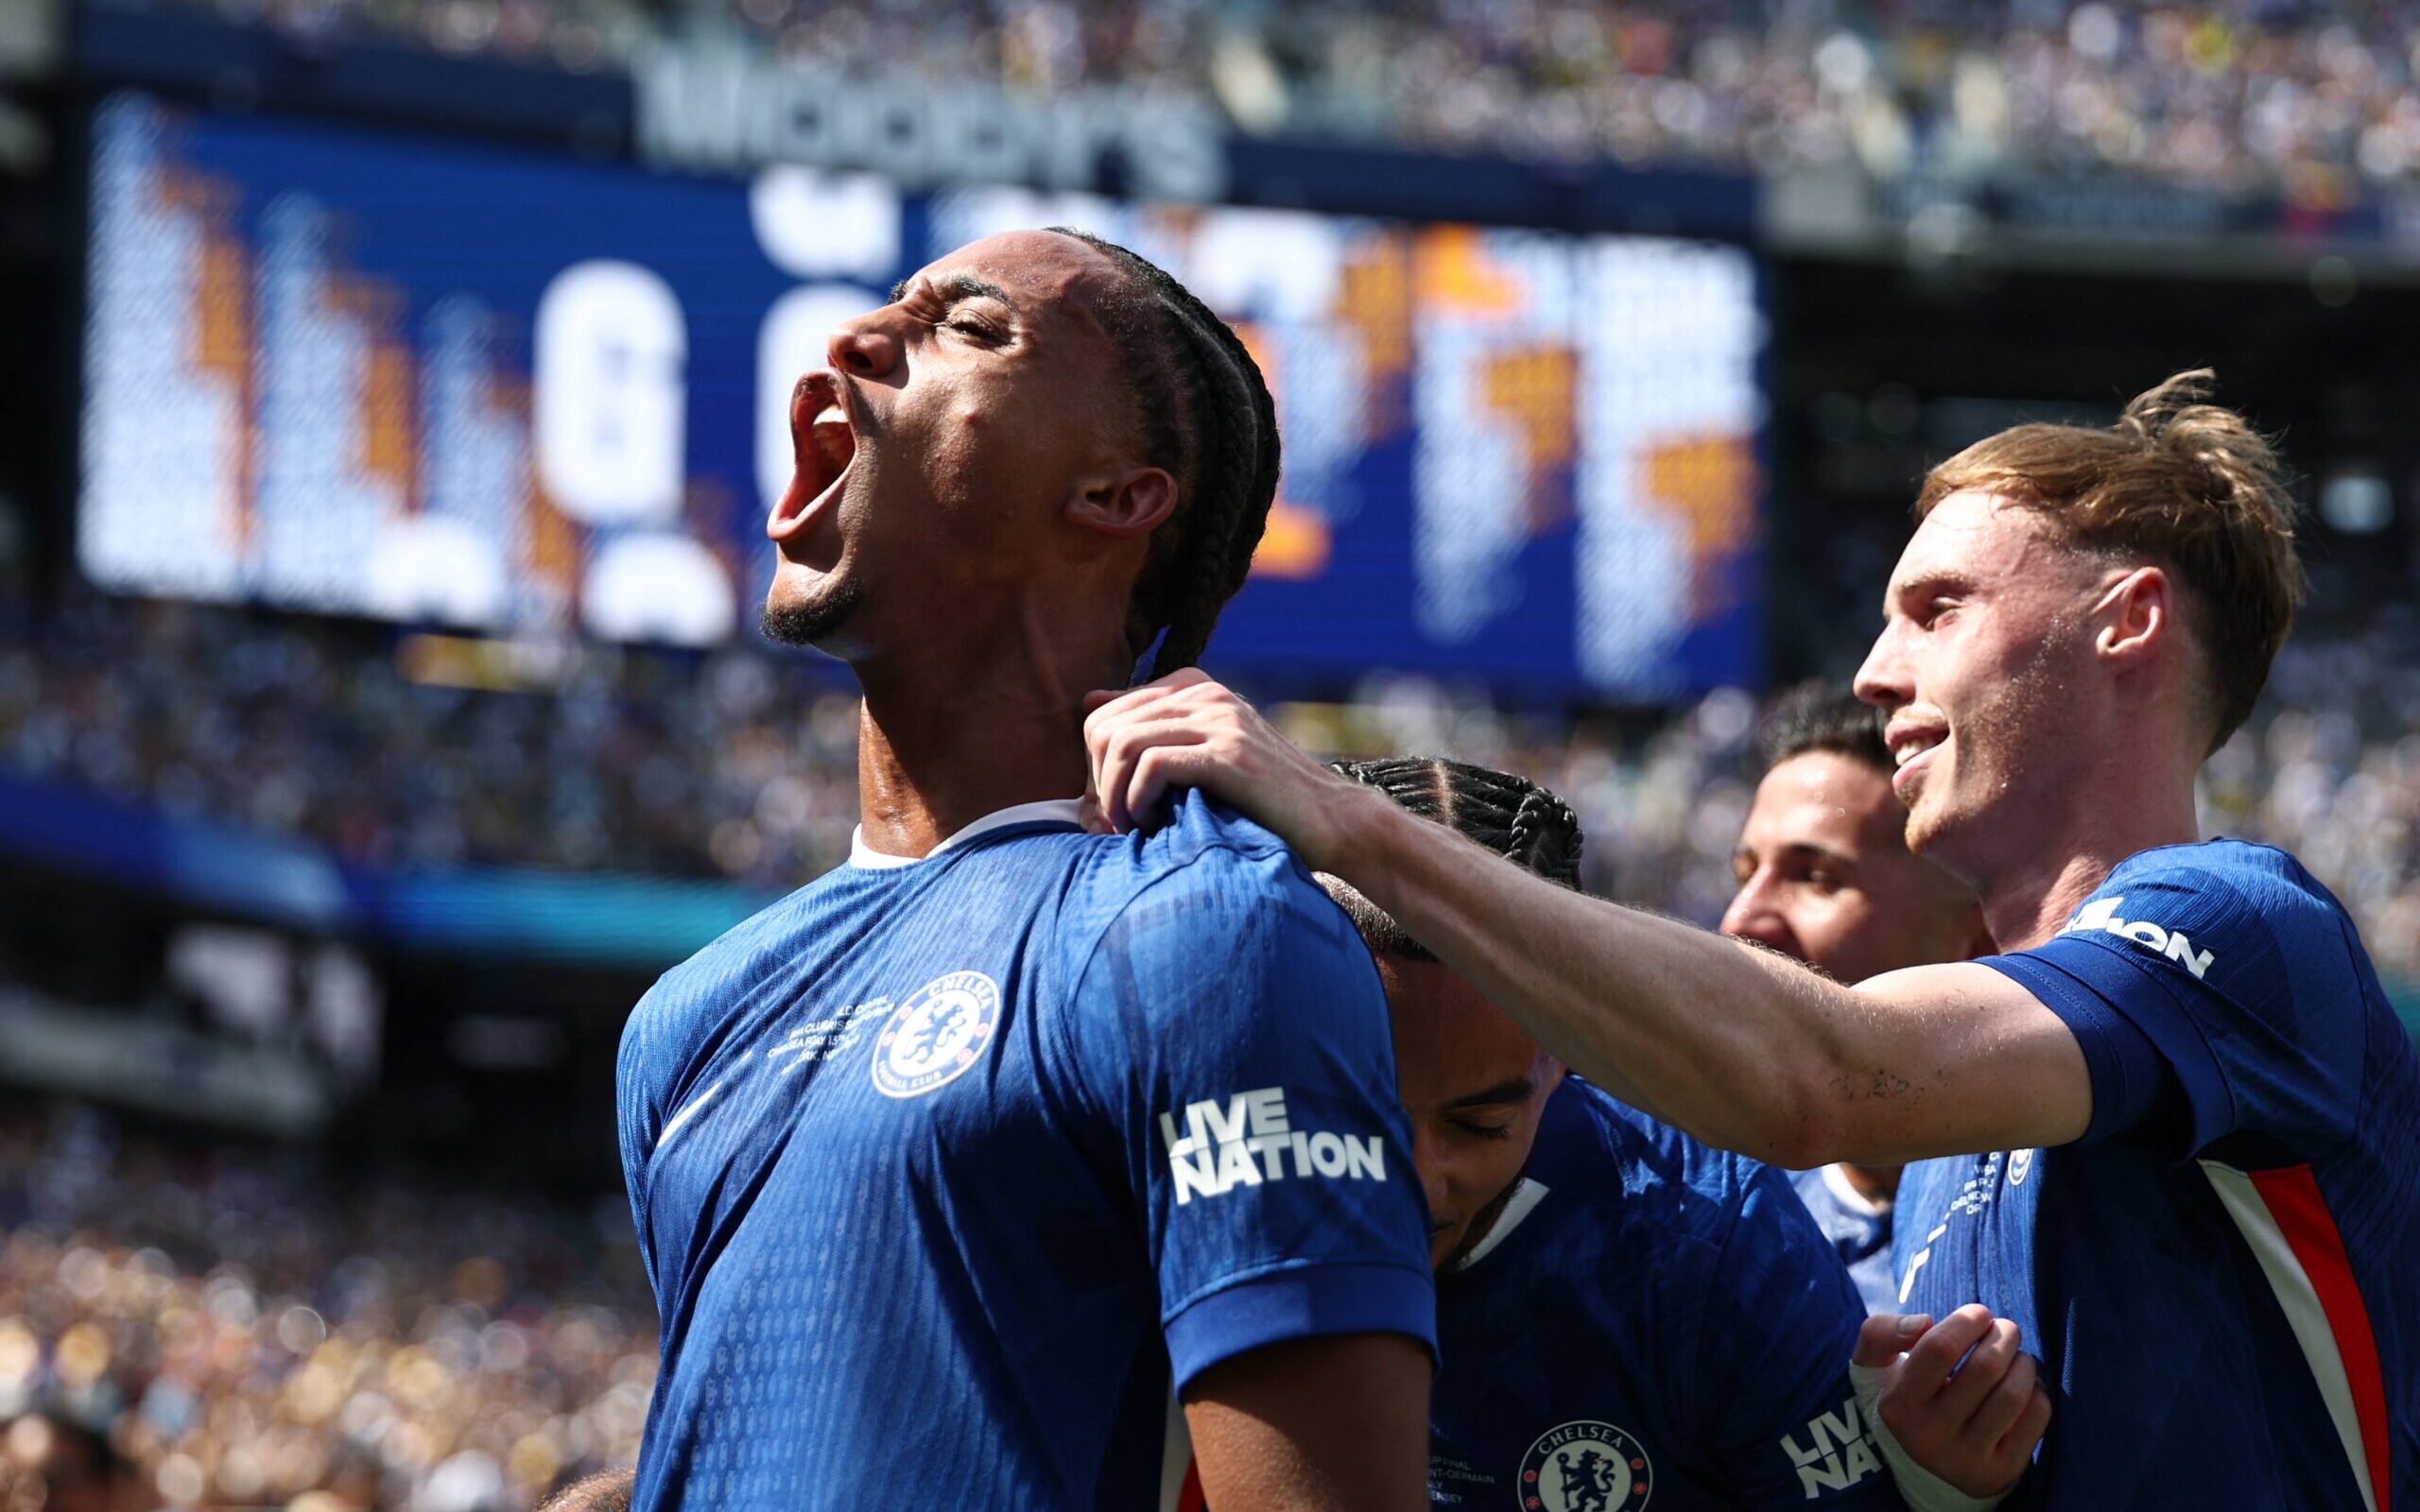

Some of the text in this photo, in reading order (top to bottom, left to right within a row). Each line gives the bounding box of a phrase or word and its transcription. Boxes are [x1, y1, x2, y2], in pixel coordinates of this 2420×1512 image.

[929, 975, 994, 1010] CHELSEA
[1158, 1086, 1290, 1158] LIVE
[1168, 1131, 1387, 1206] NATION
[1537, 1425, 1624, 1455] CHELSEA
[1777, 1395, 1862, 1469] LIV
[1429, 1468, 1495, 1486] NT-GERMAIN
[1795, 1433, 1883, 1500] NA
[1430, 1489, 1462, 1503] ERSEY
